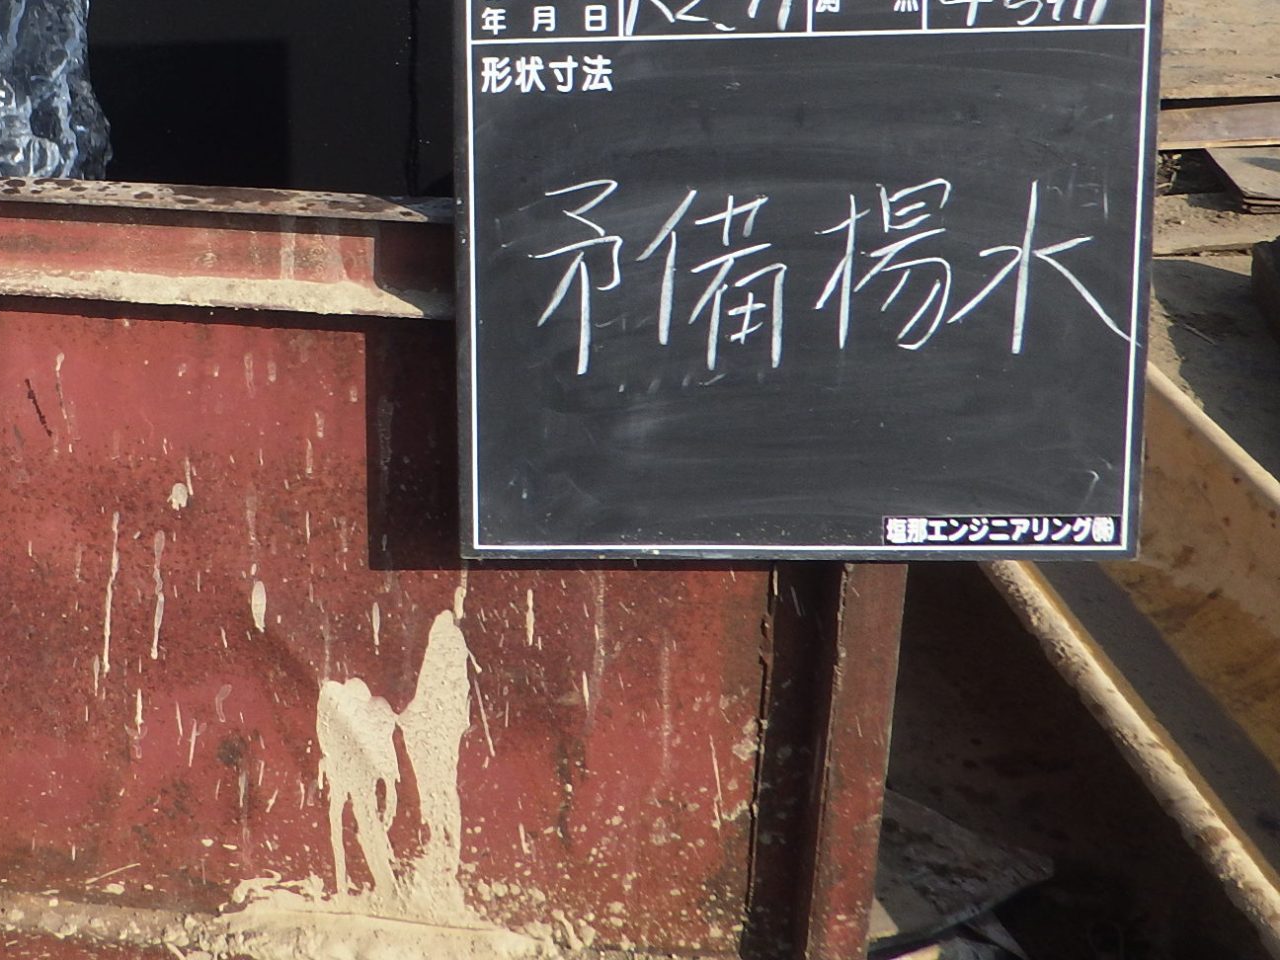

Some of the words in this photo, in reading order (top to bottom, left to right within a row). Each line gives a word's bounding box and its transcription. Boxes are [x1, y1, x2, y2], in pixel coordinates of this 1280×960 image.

[481, 5, 607, 35] 年月日
[481, 55, 613, 92] 形状寸法
